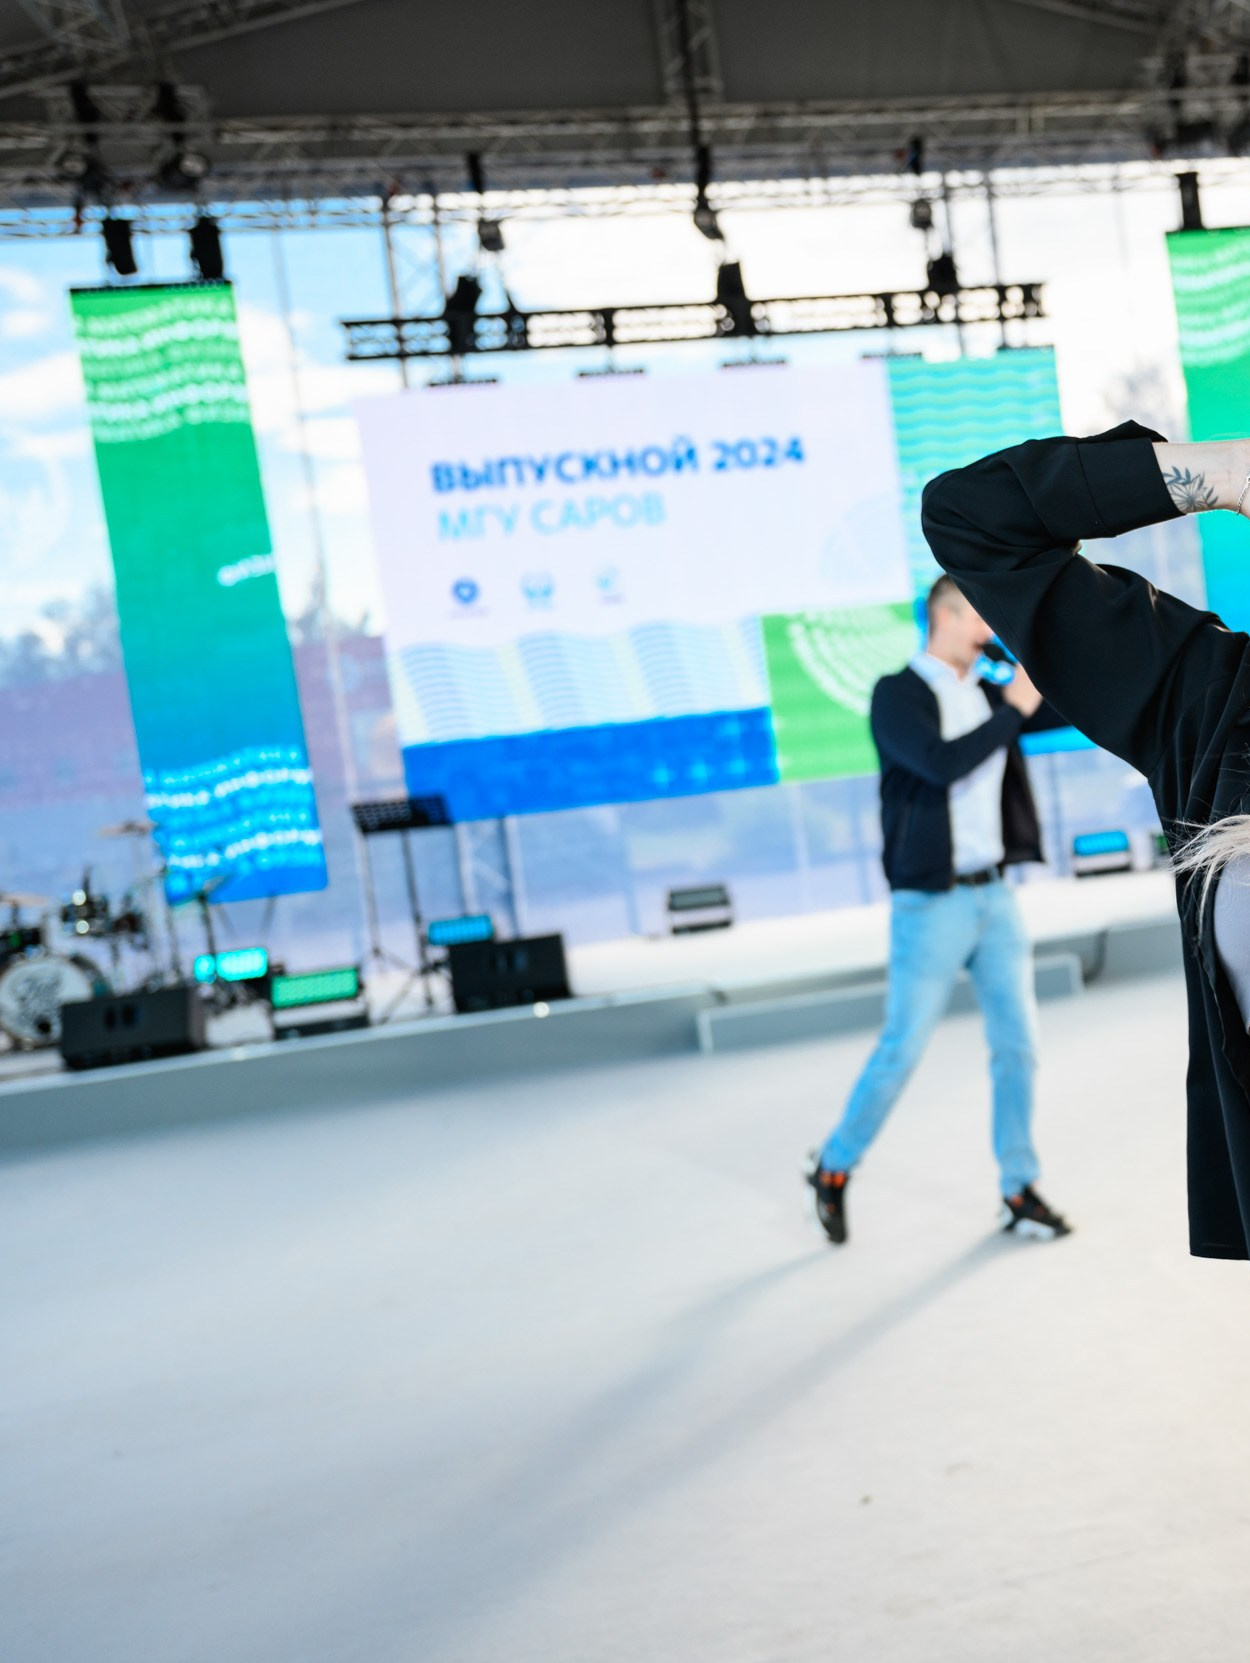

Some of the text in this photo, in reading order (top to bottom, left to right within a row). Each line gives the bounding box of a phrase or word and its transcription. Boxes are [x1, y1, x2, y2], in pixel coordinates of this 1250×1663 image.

[431, 434, 806, 493] ВЫПУСКНОЙ 2024
[438, 489, 667, 542] МГУ САРОВ
